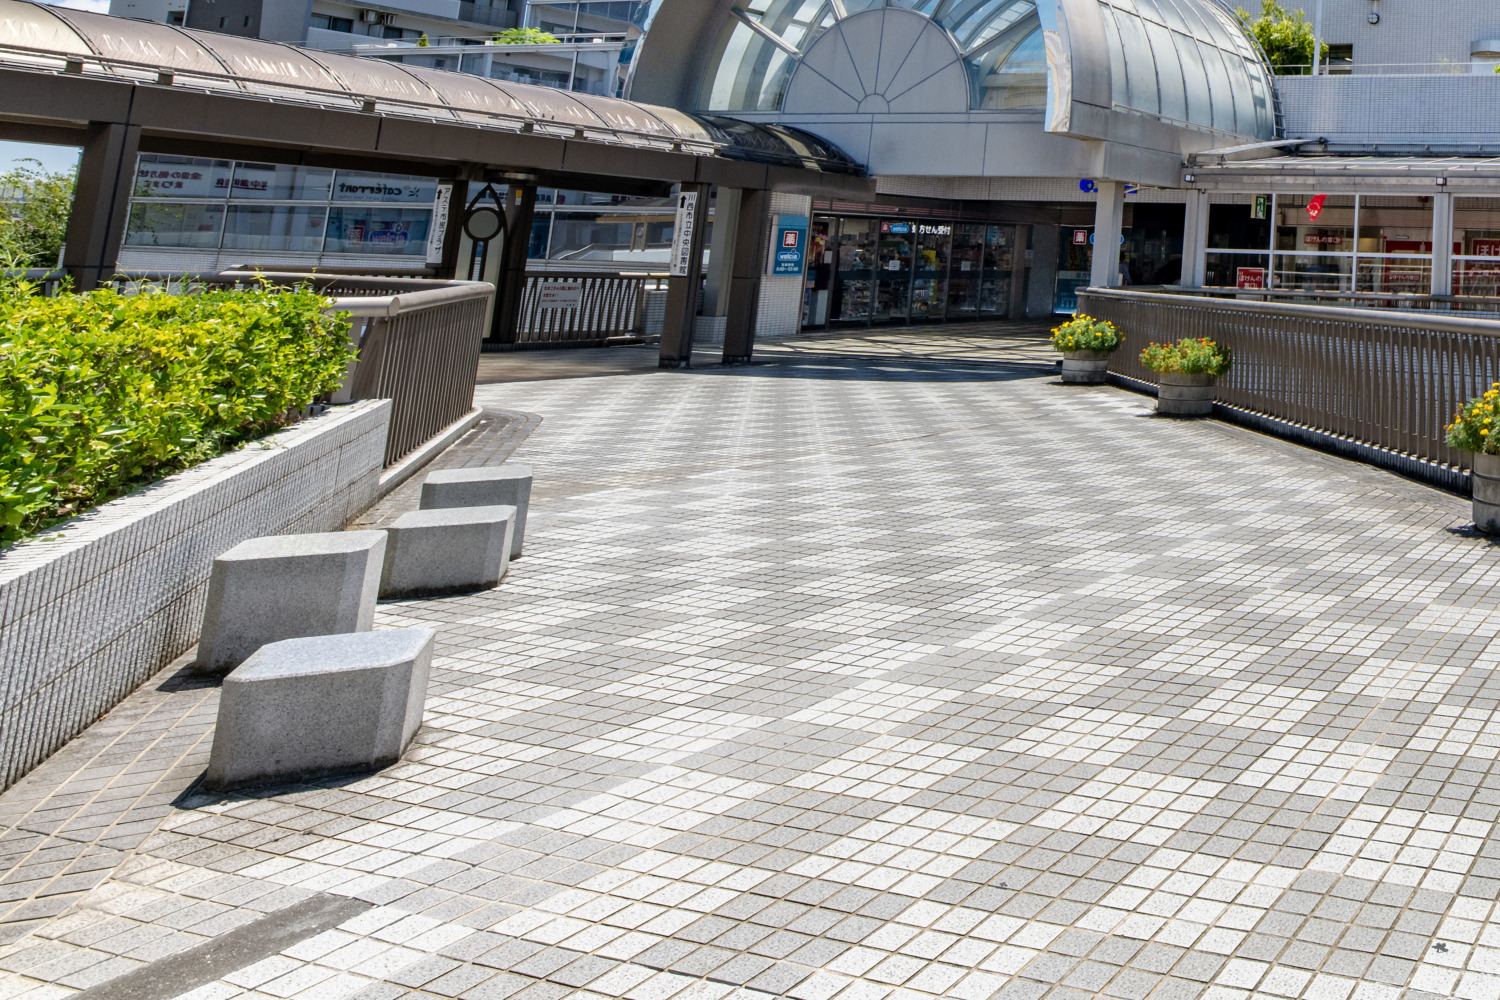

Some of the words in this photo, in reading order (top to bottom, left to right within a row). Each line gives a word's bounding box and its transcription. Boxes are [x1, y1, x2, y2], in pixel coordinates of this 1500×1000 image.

[434, 187, 451, 255] アステ市民プラザ
[679, 193, 697, 275] 川西市立中央図書館
[785, 233, 796, 245] 薬
